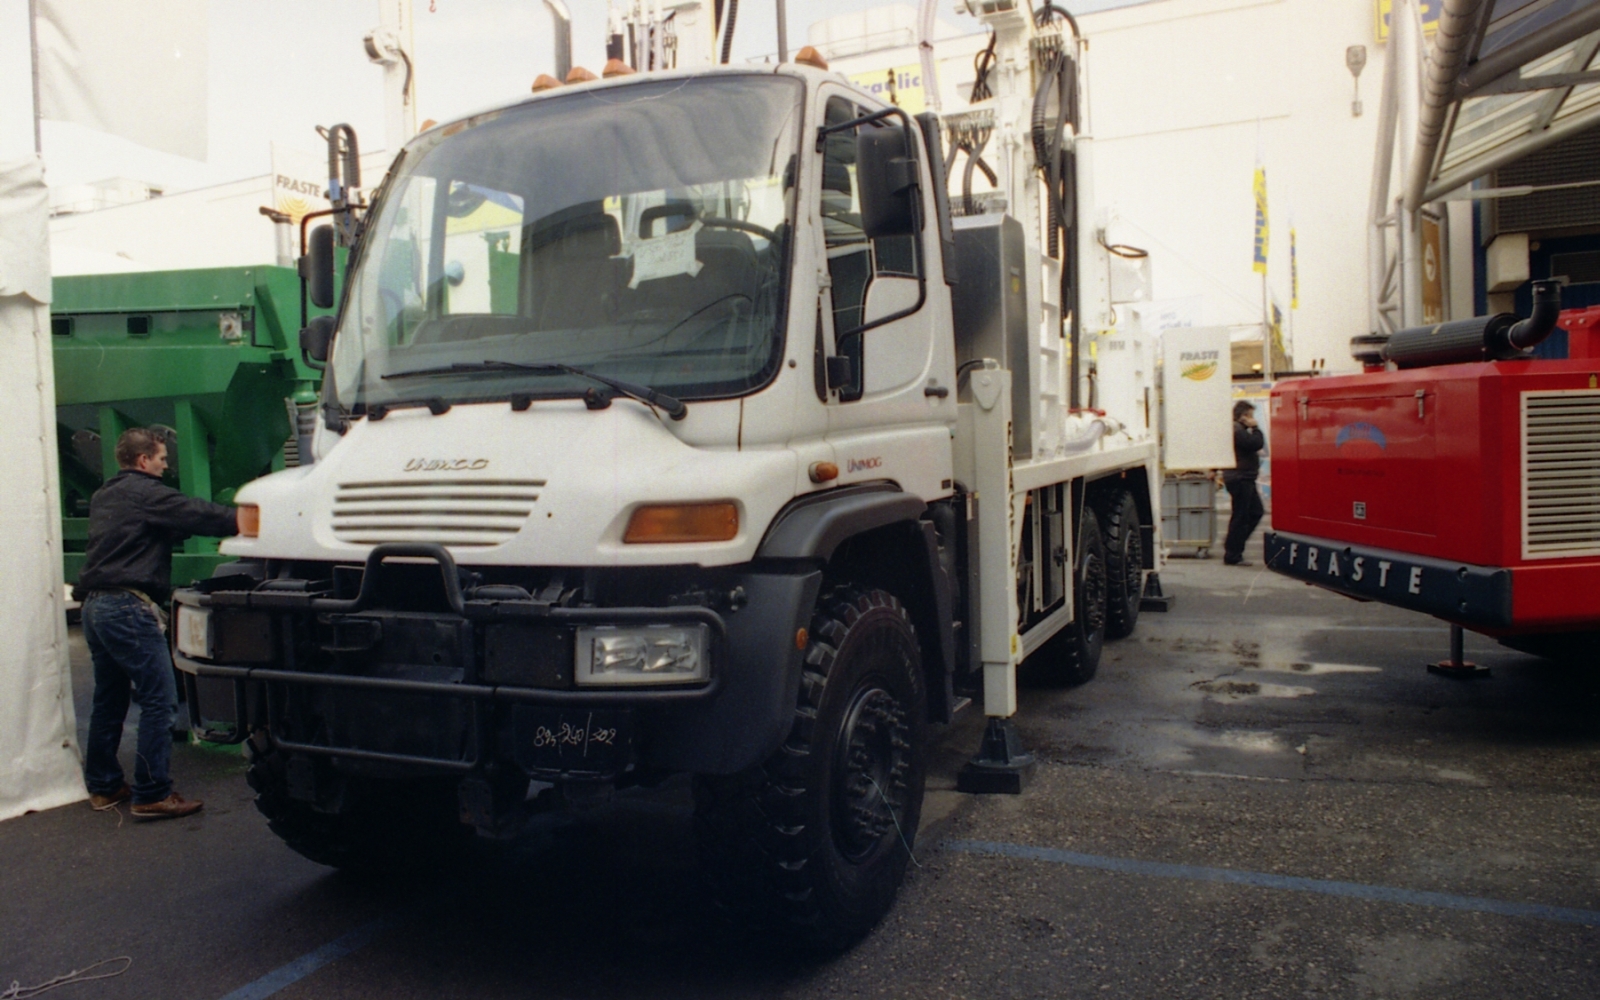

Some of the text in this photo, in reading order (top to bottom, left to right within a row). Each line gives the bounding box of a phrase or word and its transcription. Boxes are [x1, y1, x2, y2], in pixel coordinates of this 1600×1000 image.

[276, 174, 321, 198] FRASTE
[1180, 350, 1219, 361] FRASTE
[1289, 543, 1423, 594] FRASTE
